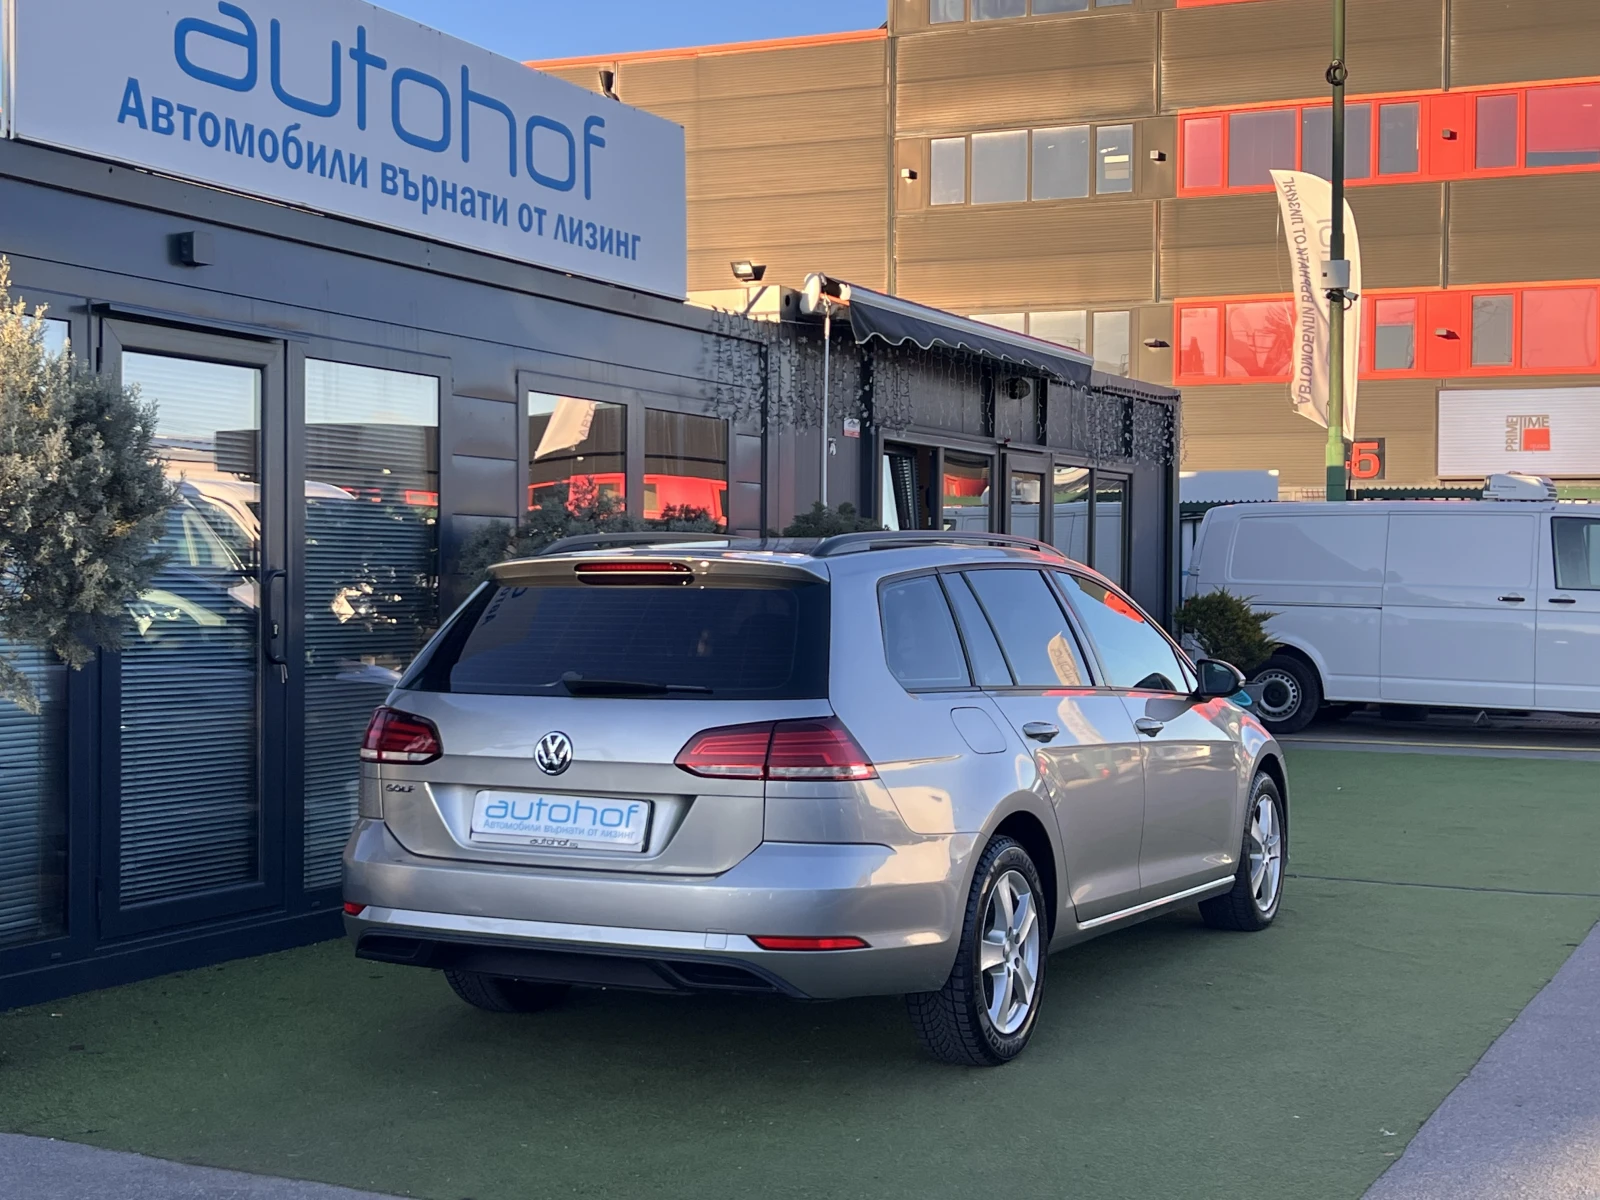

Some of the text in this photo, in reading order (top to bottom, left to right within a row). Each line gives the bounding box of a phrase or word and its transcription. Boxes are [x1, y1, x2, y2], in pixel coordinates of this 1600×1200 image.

[174, 1, 606, 200] autohof
[117, 77, 641, 261] Автомобили върнати от лизинг
[1505, 415, 1518, 452] PRIME
[385, 783, 415, 792] GOLF
[483, 819, 635, 839] Автомобили върнати от лизинг
[485, 797, 639, 828] autohof
